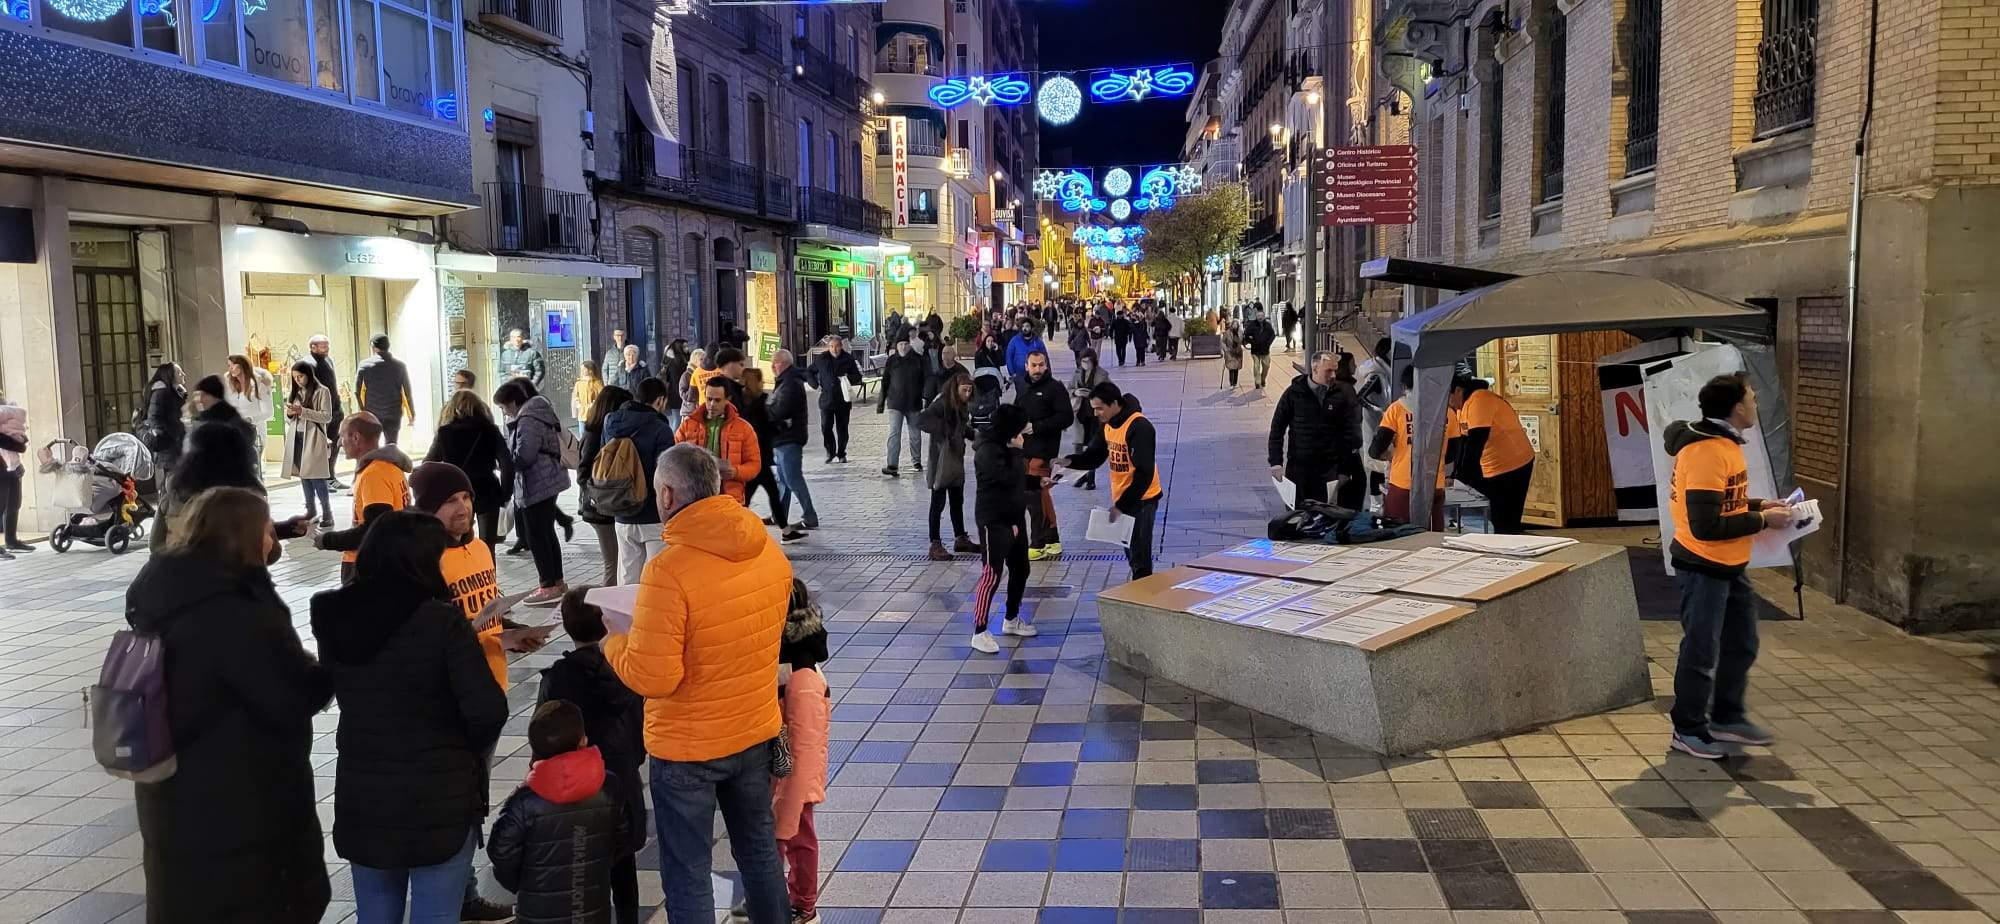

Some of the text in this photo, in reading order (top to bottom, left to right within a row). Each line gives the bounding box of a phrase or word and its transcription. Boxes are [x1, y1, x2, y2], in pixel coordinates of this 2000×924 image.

[250, 34, 300, 73] bravo
[387, 76, 424, 105] bravo
[895, 121, 906, 226] FARMACIA
